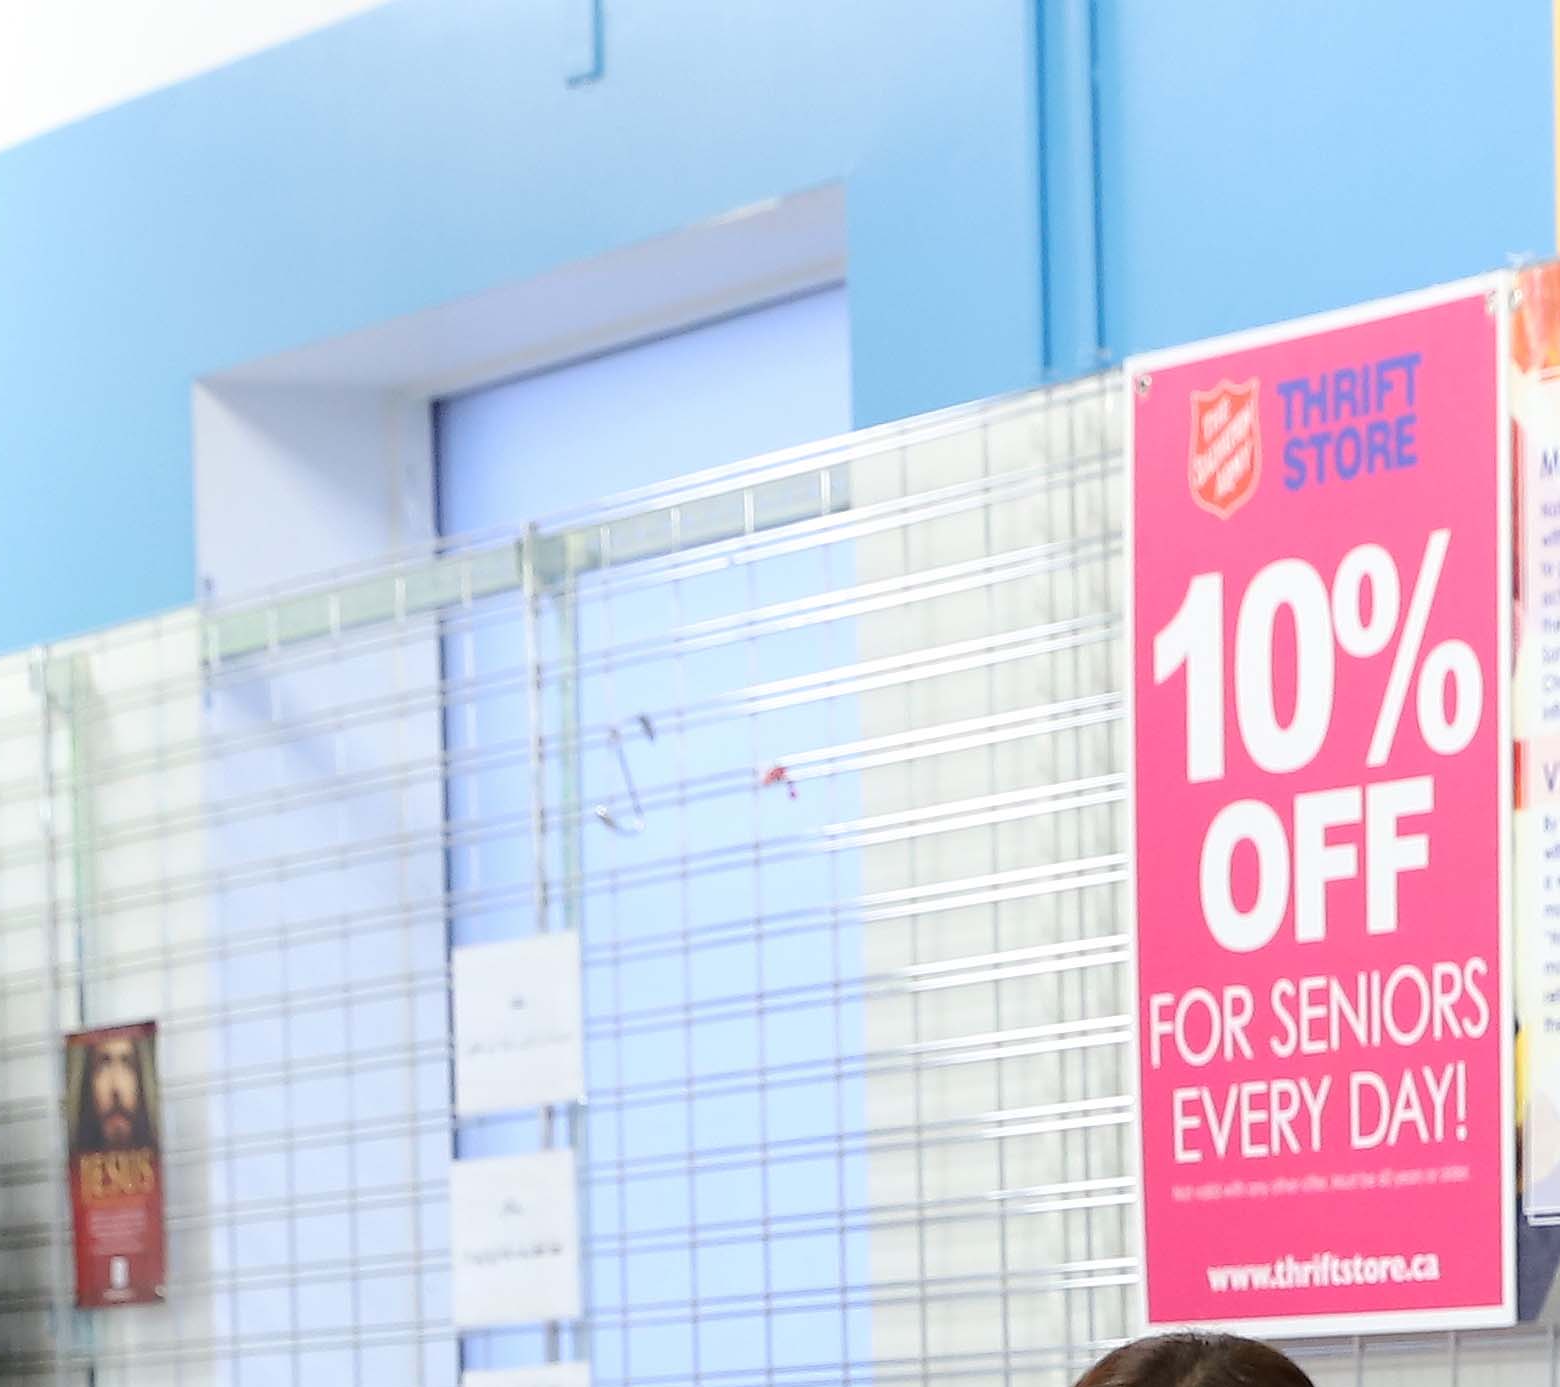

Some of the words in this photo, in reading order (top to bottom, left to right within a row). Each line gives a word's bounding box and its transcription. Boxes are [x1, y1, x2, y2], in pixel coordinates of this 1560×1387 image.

[1277, 354, 1422, 429] THRIFT
[1282, 415, 1419, 492] STORE
[1152, 528, 1483, 784] 10%
[1200, 777, 1436, 952] OFF
[1149, 985, 1253, 1069] FOR
[1270, 956, 1490, 1057] SENIORS
[1172, 1073, 1331, 1164] EVERY
[1350, 1061, 1469, 1146] DAY!
[1206, 1250, 1440, 1292] www.thriftstore.ca
